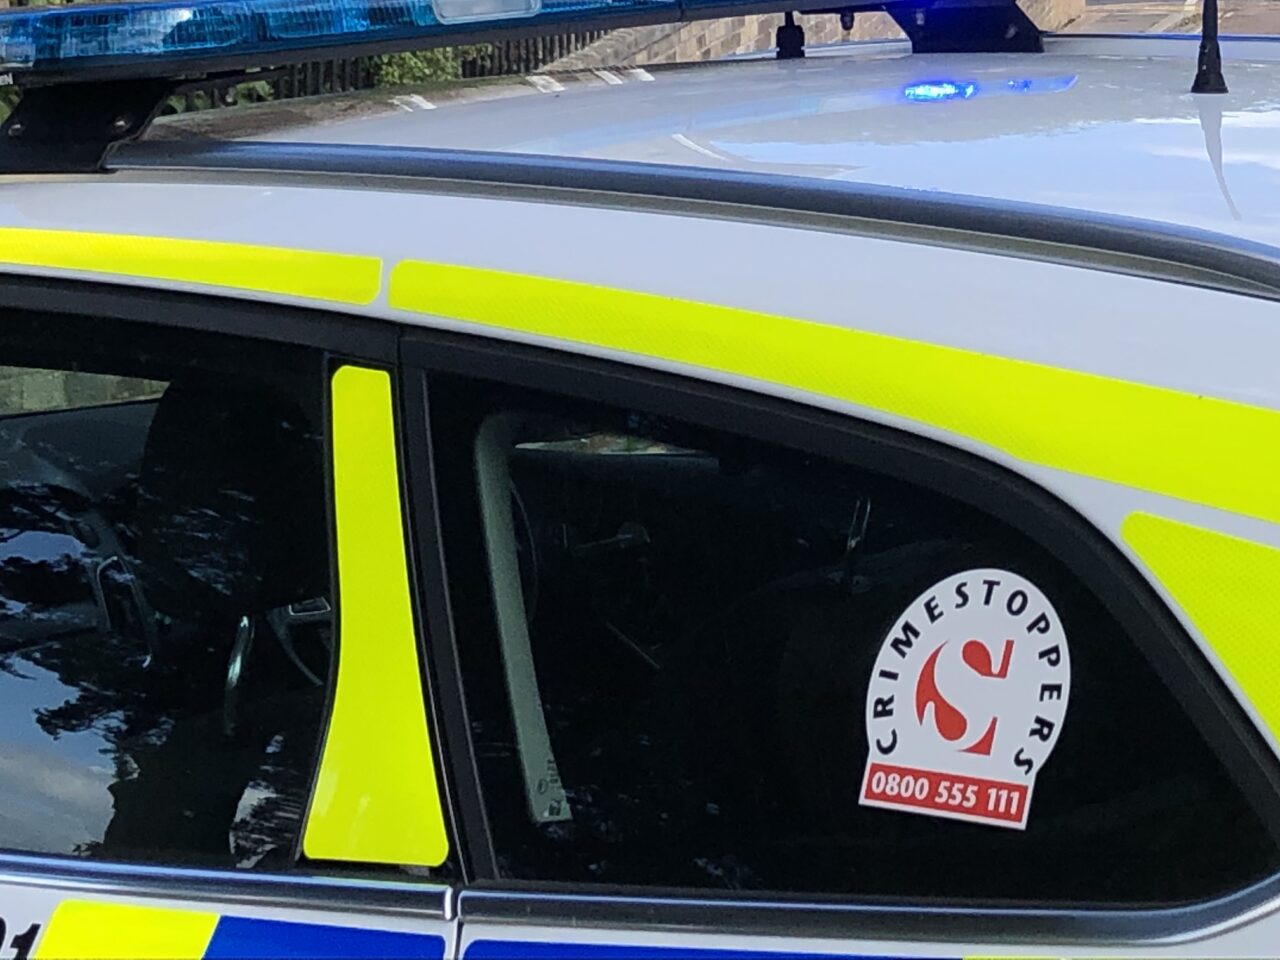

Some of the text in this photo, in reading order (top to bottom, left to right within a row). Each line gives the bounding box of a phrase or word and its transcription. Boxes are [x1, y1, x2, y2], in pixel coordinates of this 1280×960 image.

[873, 579, 1062, 776] CRIMESTOPPERS
[871, 771, 1021, 815] 0800 555 111
